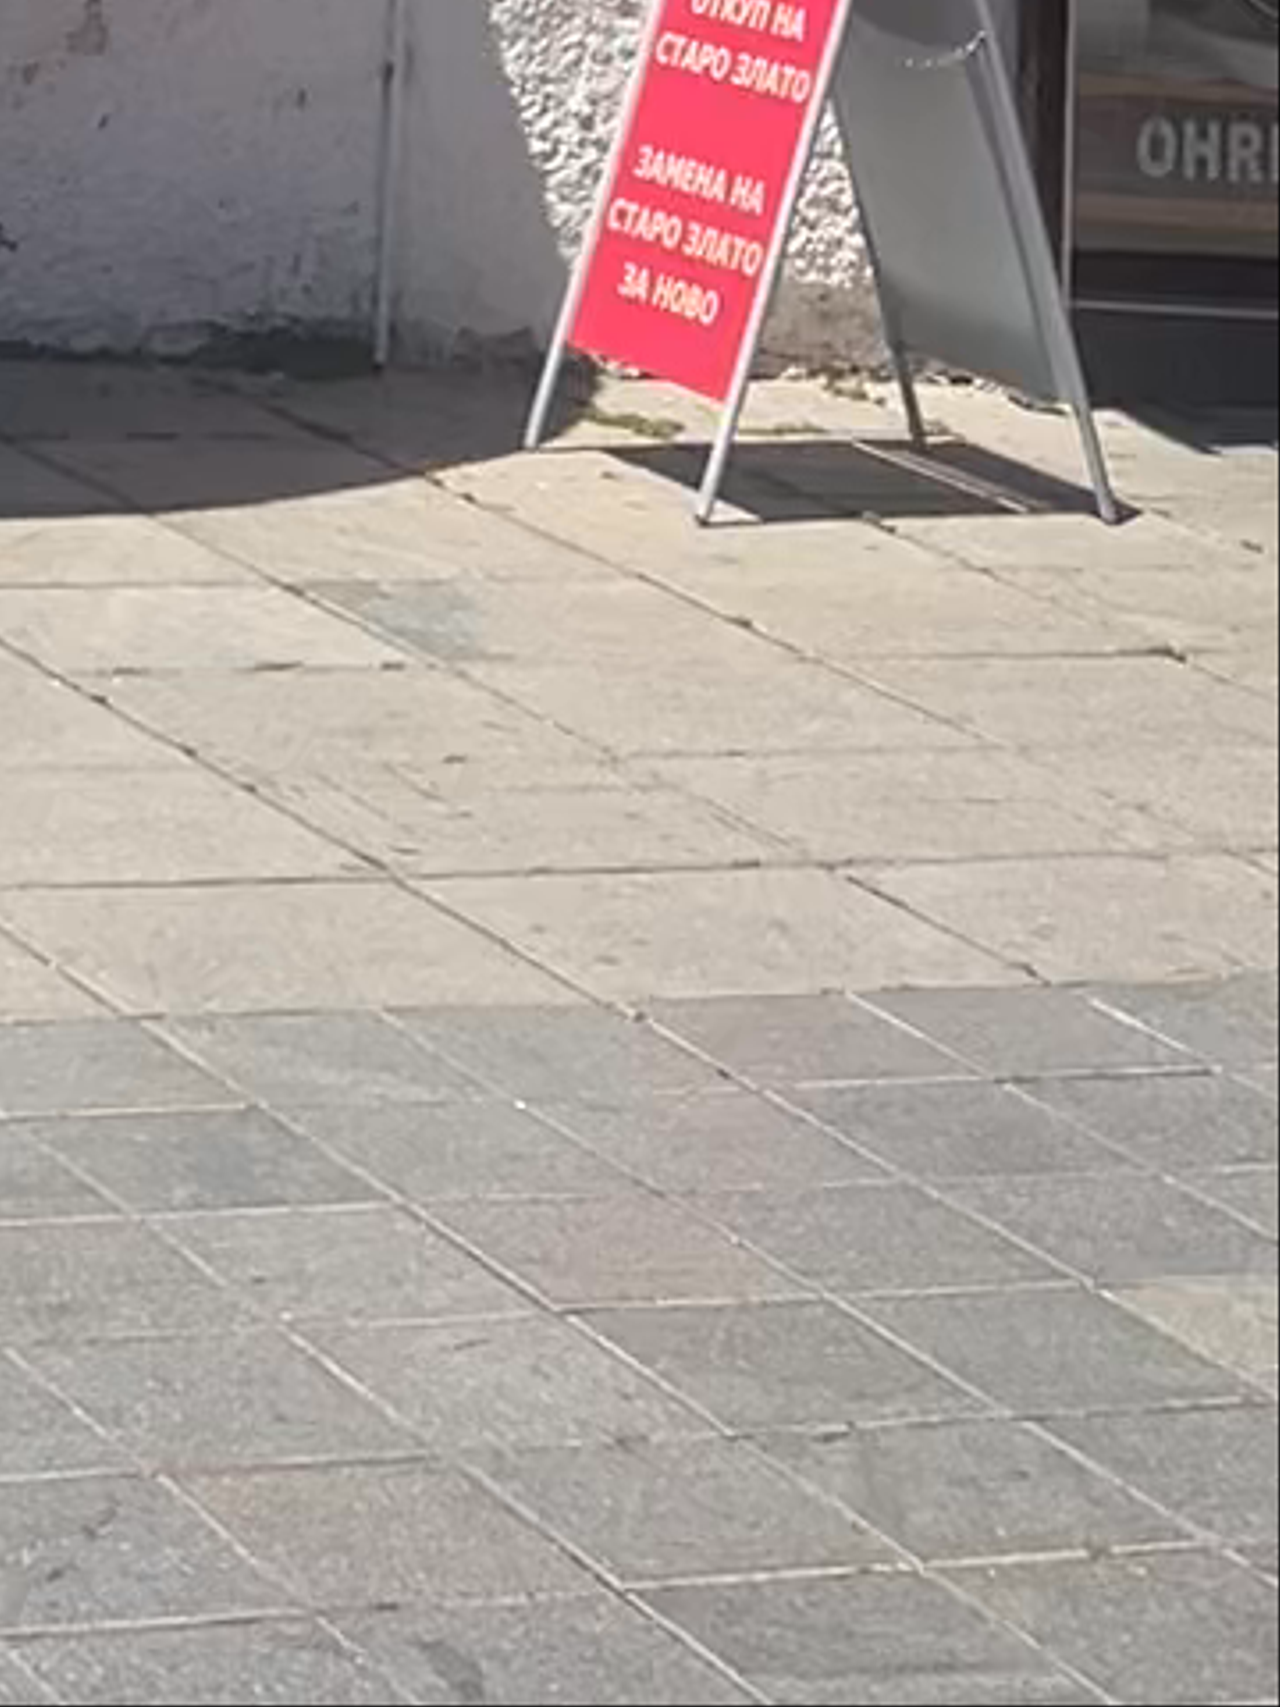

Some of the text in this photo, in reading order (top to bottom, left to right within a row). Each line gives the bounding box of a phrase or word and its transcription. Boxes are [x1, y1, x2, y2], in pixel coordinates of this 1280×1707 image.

[770, 1, 806, 42] НА
[655, 32, 811, 103] СТАРО ЗЛАТО
[633, 144, 765, 215] ЗАМЕНА НА
[608, 197, 763, 277] СТАРО ЗЛАТО
[617, 262, 719, 325] ЗА НОВО
